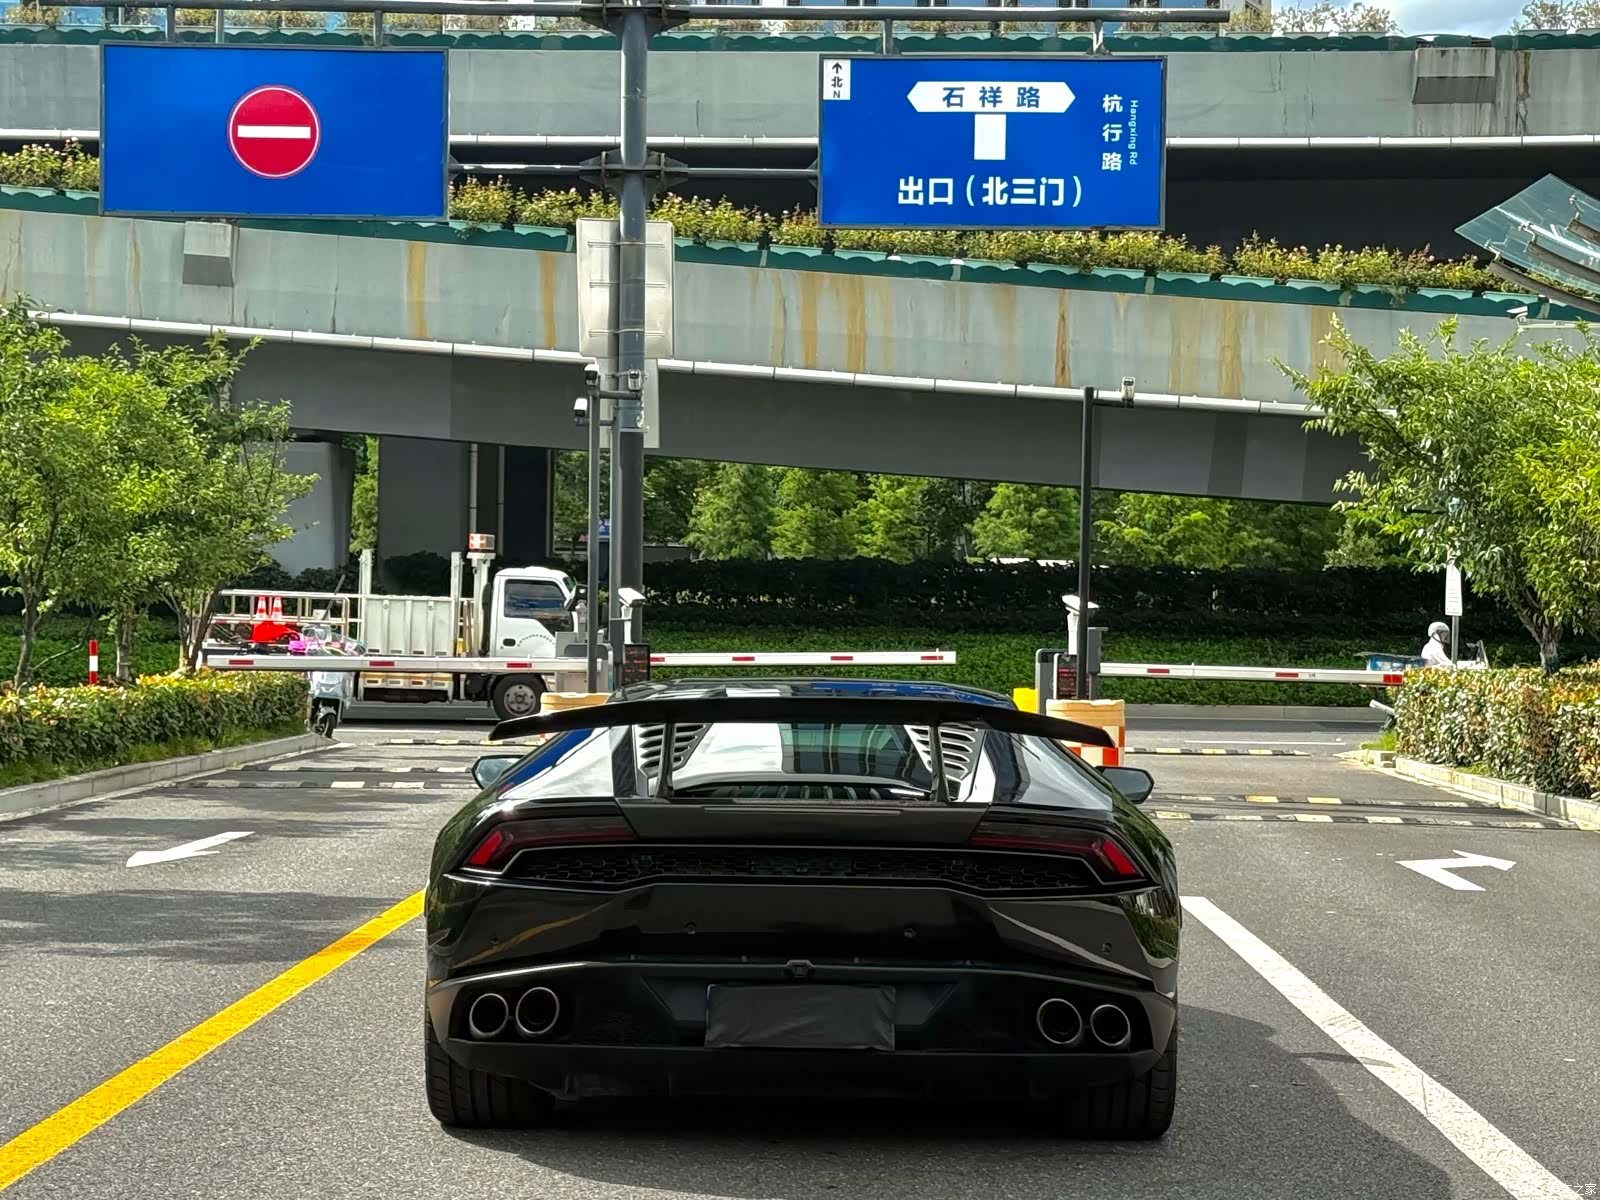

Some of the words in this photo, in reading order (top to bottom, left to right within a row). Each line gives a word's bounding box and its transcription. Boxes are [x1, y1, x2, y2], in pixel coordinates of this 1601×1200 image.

[831, 76, 843, 88] 北
[833, 90, 841, 98] N
[942, 86, 1041, 108] 石祥路
[1102, 94, 1123, 171] 杭行路
[1128, 100, 1139, 149] Hangxing
[1129, 152, 1138, 166] Rd
[898, 175, 1082, 207] 出口（北三门）
